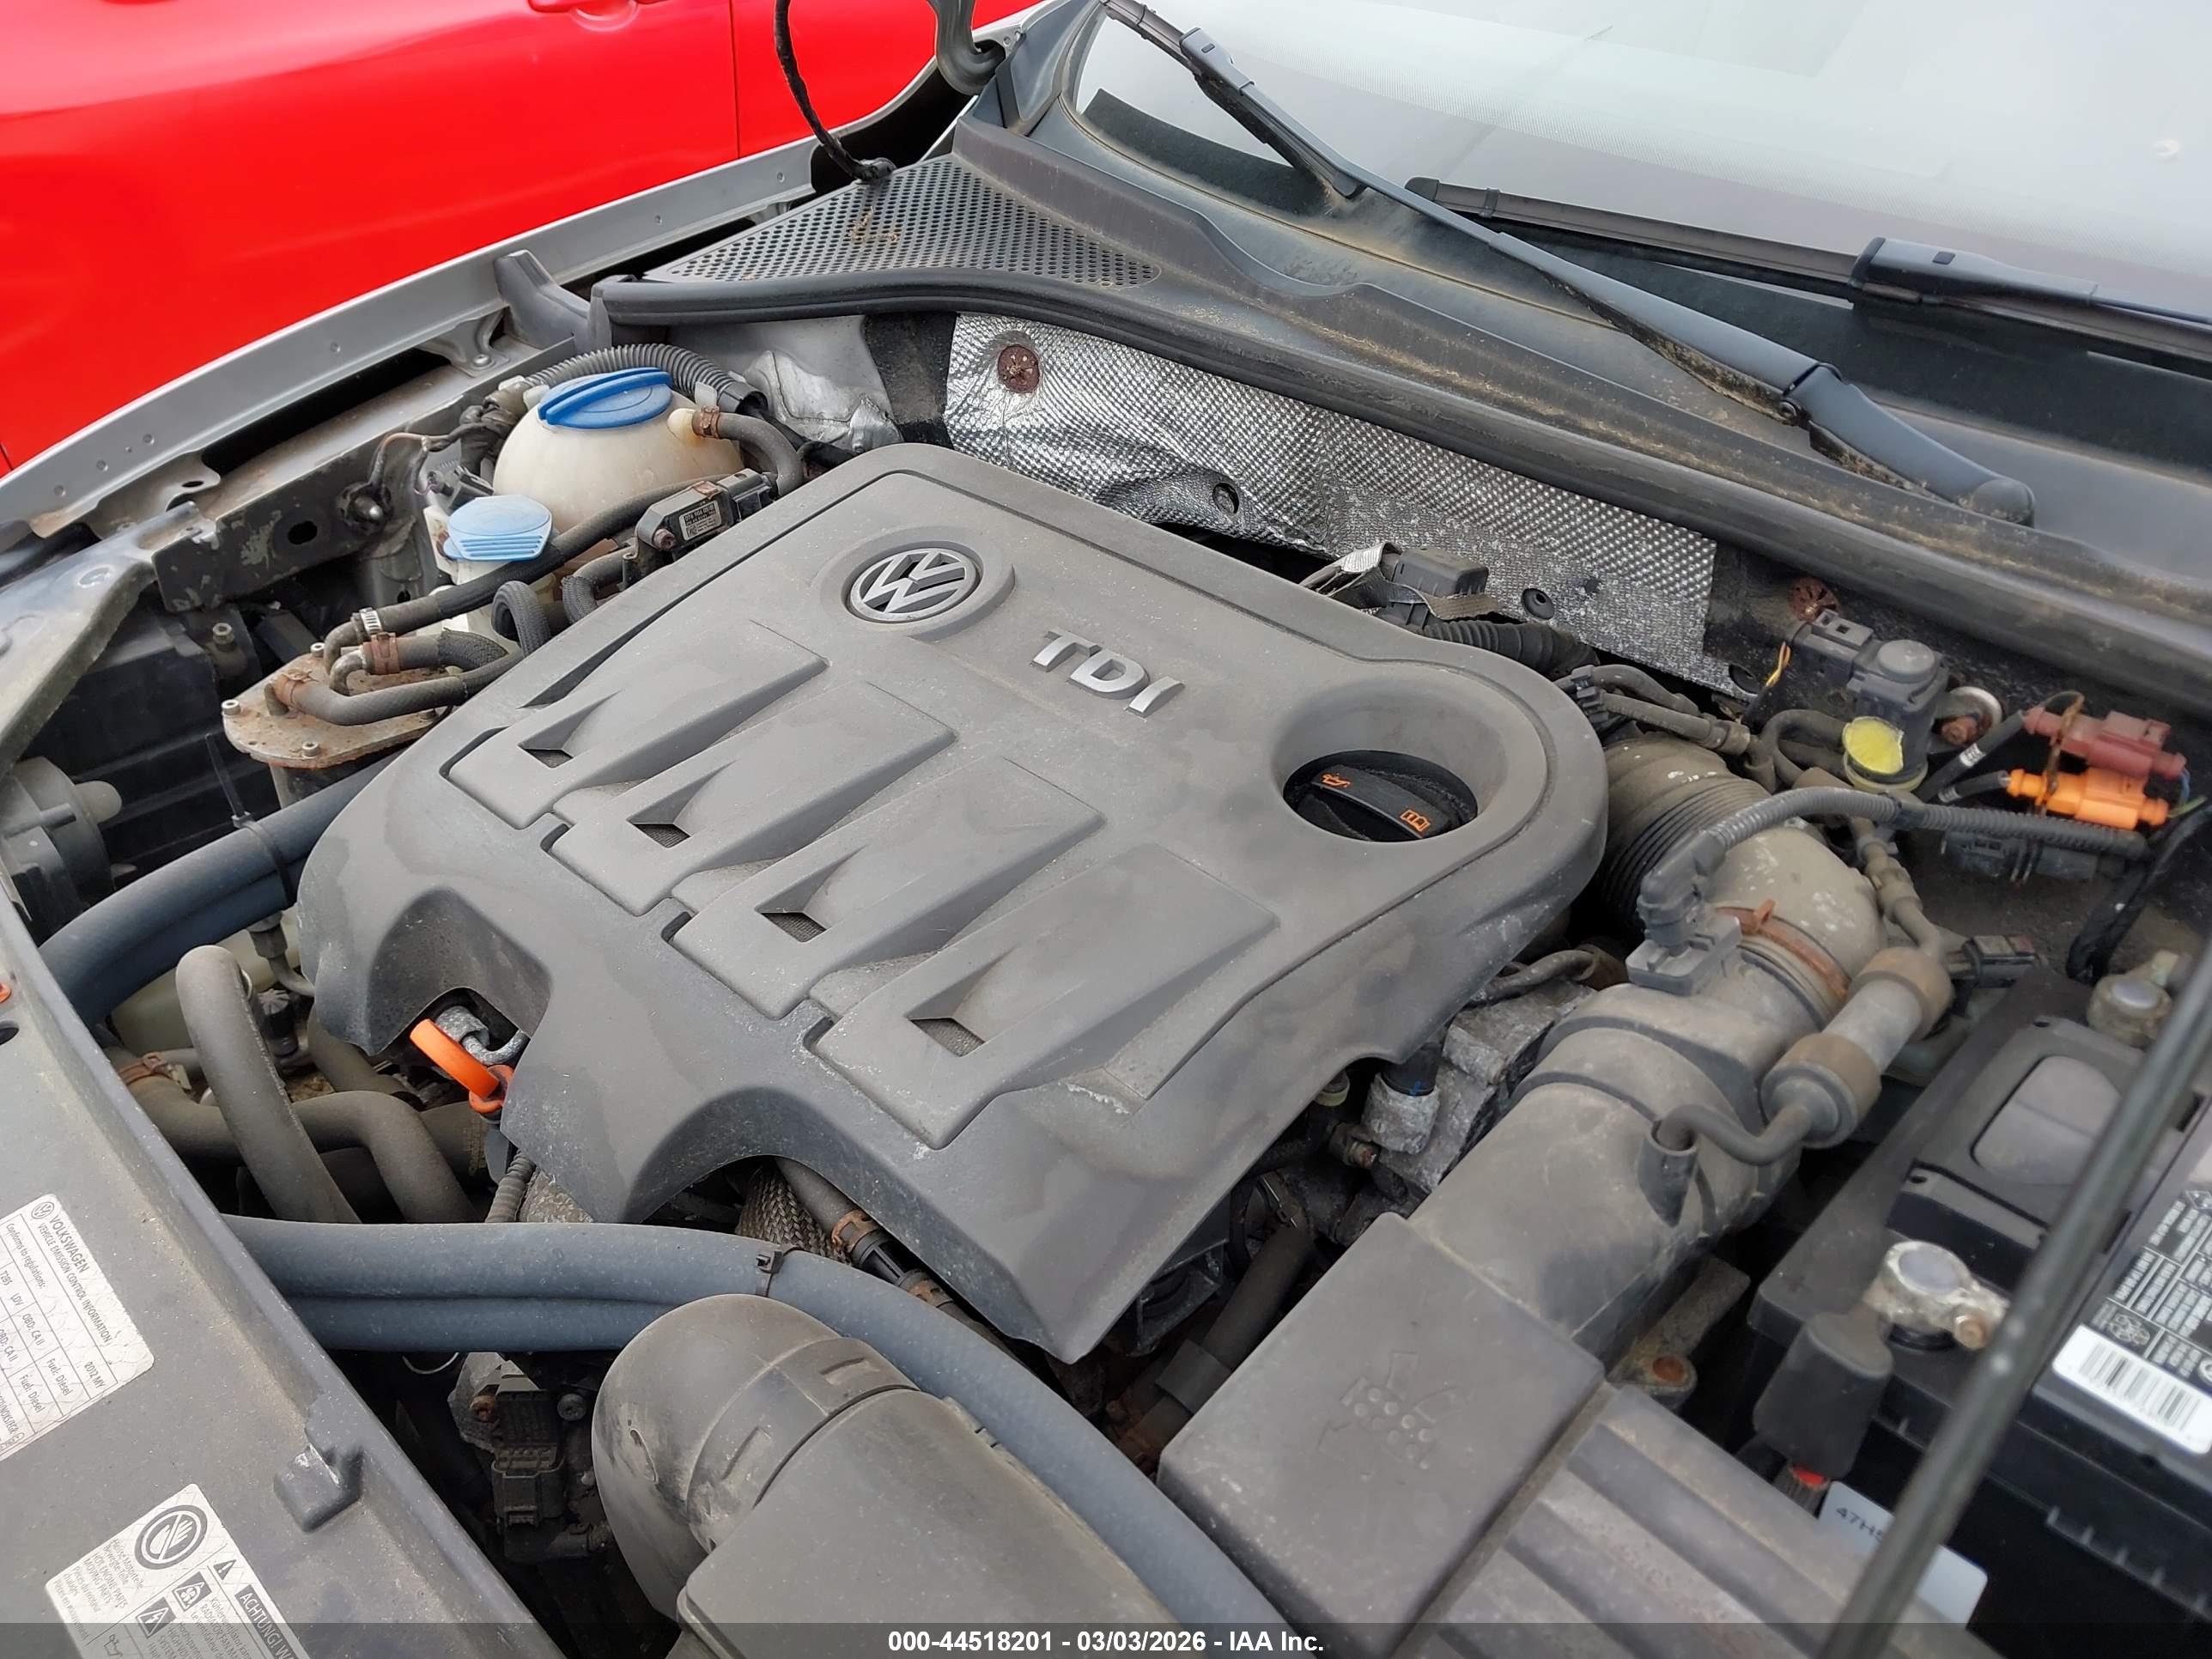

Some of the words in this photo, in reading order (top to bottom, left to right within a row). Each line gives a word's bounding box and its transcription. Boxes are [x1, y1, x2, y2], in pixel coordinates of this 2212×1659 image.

[1030, 628, 1186, 718] TDI
[5, 1222, 26, 1250] Conforms
[19, 1247, 28, 1256] to
[48, 1214, 90, 1273] VOLKSWAGEN
[21, 1254, 48, 1290] regulations:
[36, 1222, 55, 1247] VEHICLE
[49, 1244, 70, 1274] EMISSION
[64, 1272, 86, 1300] CONTROL
[81, 1298, 112, 1344] INFORMATION
[20, 1311, 36, 1331] OBD:
[18, 1373, 33, 1393] Fuel:
[27, 1390, 46, 1413] Diesel
[45, 1358, 61, 1376] Fuel:
[54, 1374, 72, 1396] Diesel
[83, 1361, 98, 1378] 2012
[92, 1375, 105, 1389] MY
[238, 1589, 283, 1649] ACHTUNG!
